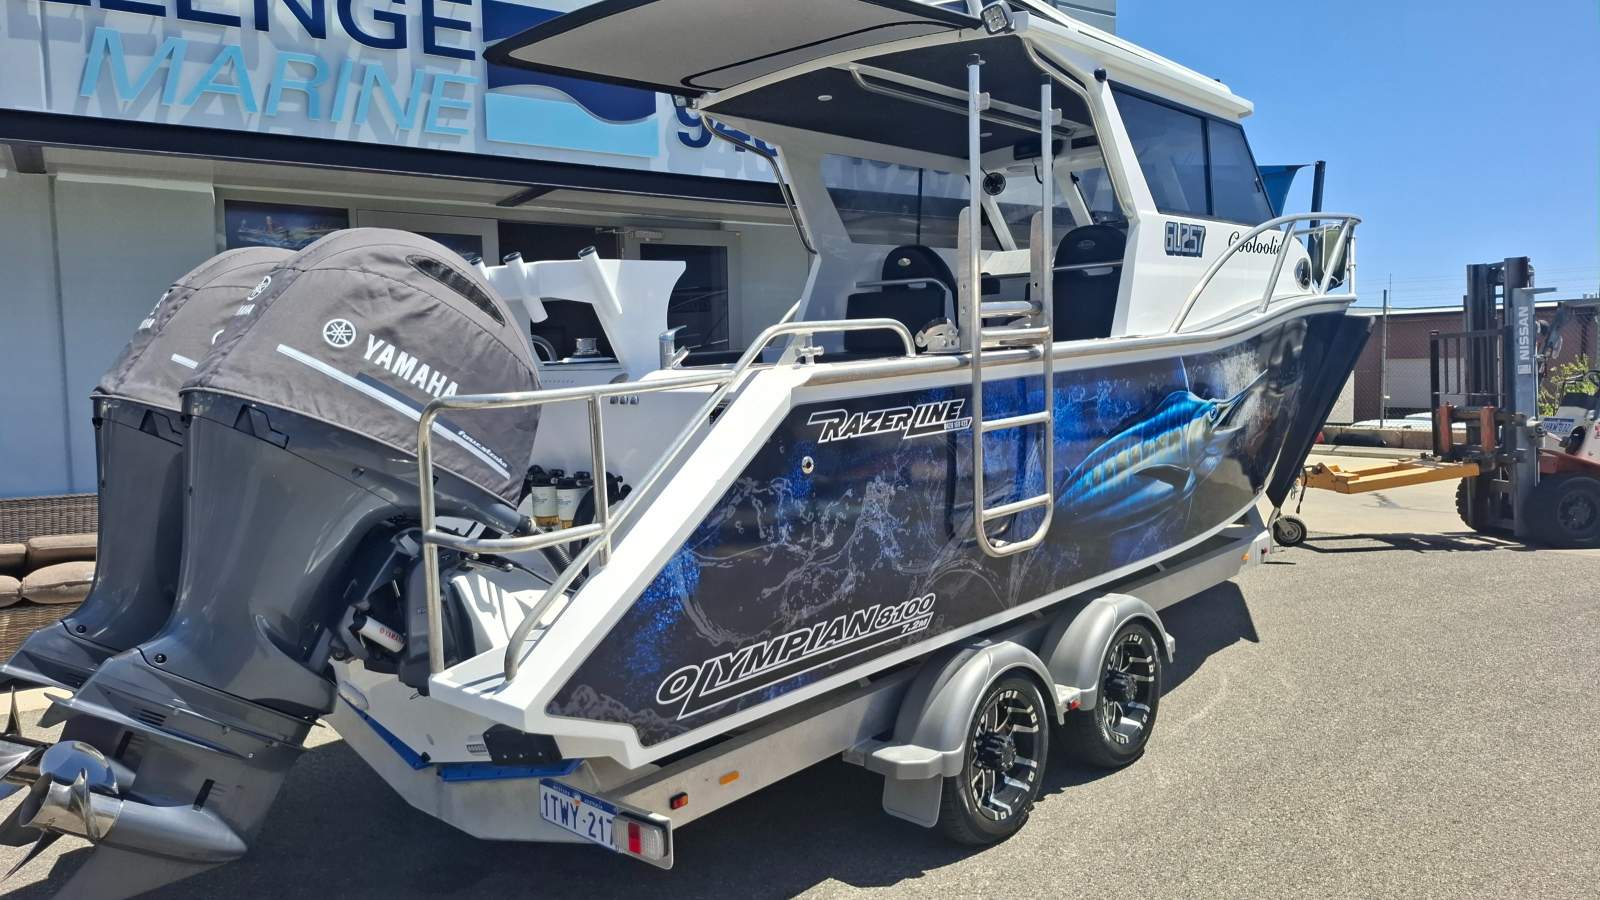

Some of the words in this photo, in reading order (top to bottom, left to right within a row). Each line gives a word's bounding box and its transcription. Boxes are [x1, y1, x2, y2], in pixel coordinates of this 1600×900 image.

[79, 26, 480, 136] MARINE
[363, 333, 459, 398] YAMAHA
[1518, 306, 1530, 361] NISSAN
[806, 398, 968, 444] RAZERLINE
[655, 603, 881, 721] OLYMPIAN
[874, 592, 937, 630] 8100
